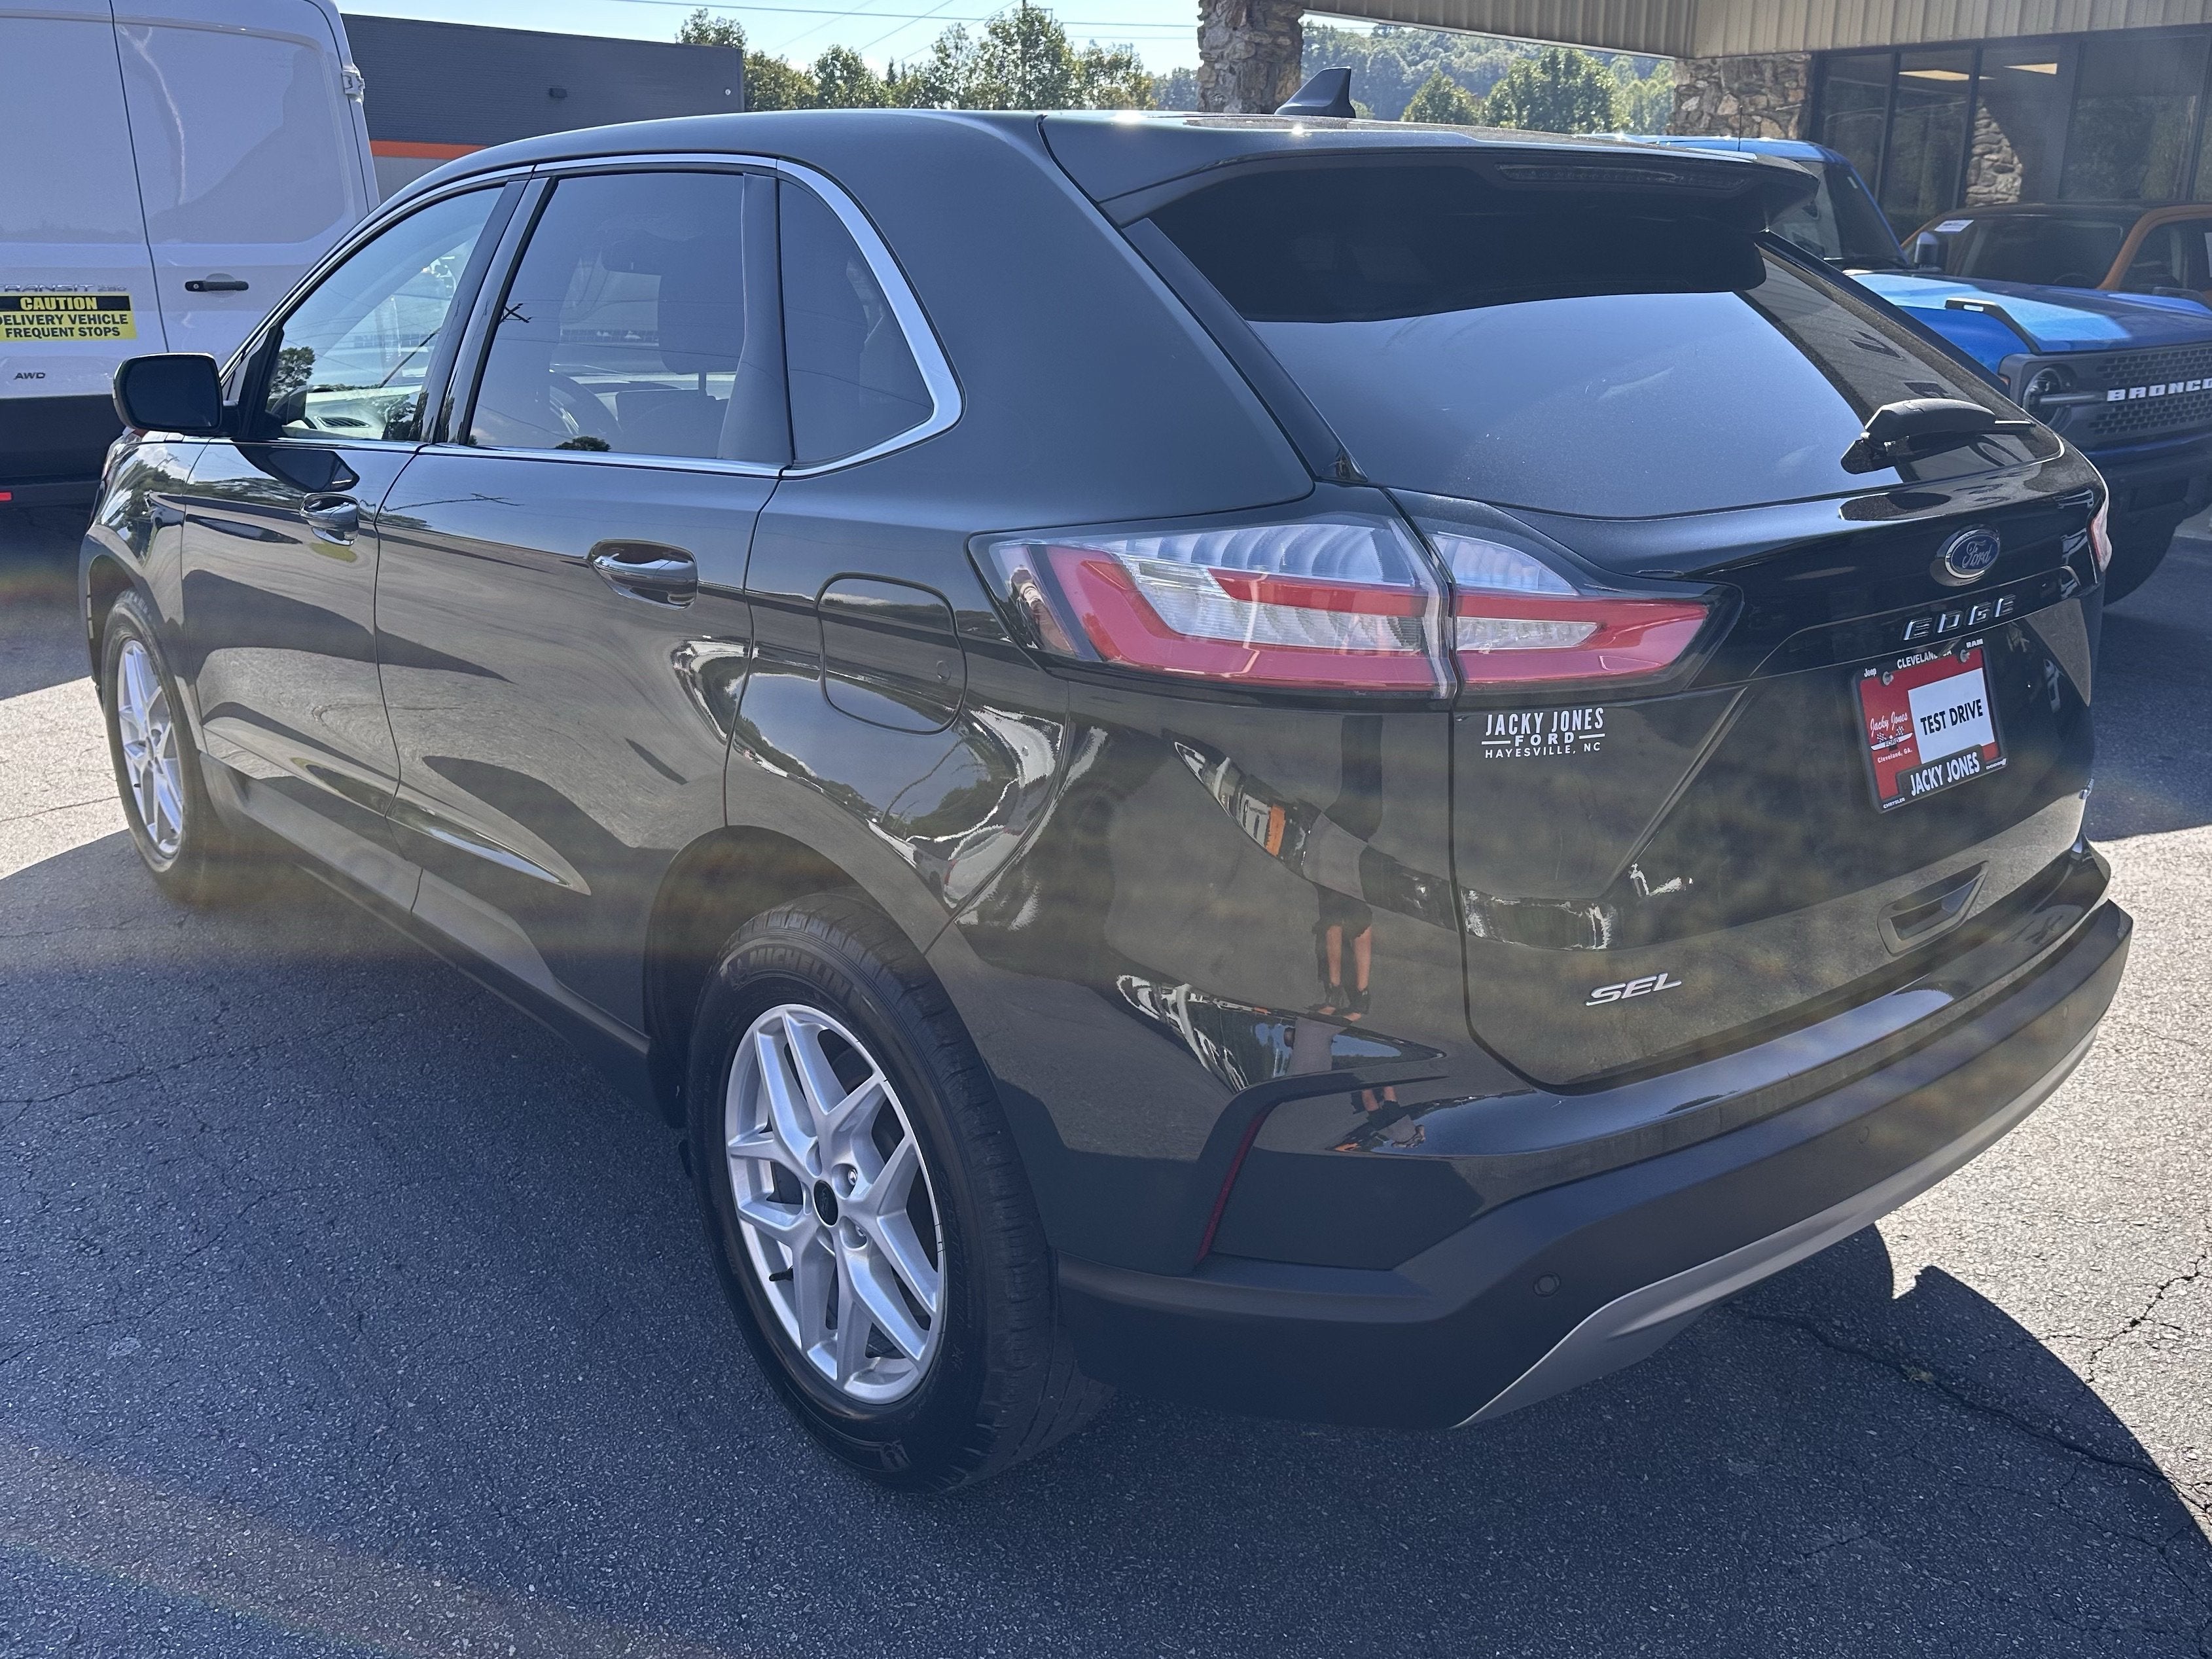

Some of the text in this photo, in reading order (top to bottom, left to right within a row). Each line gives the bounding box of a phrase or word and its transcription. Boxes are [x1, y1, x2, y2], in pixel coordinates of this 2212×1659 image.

[20, 297, 98, 310] CAUTION
[68, 313, 128, 325] VEHICLE
[5, 327, 120, 338] FREQUENT STOPS
[14, 372, 46, 380] AWD
[1961, 540, 1992, 569] Ford
[1902, 594, 2016, 641] EDGE
[1966, 639, 1984, 649] RAM
[1486, 707, 1604, 736] JACKY JONES
[1870, 711, 1908, 738] Jacky Jones
[1920, 698, 1984, 736] TEST DRIVE
[1485, 742, 1601, 758] HAYESVILLE, NC
[1514, 732, 1575, 747] FORD
[1910, 752, 1980, 796] JACKY JONES
[1585, 972, 1682, 1007] SEL
